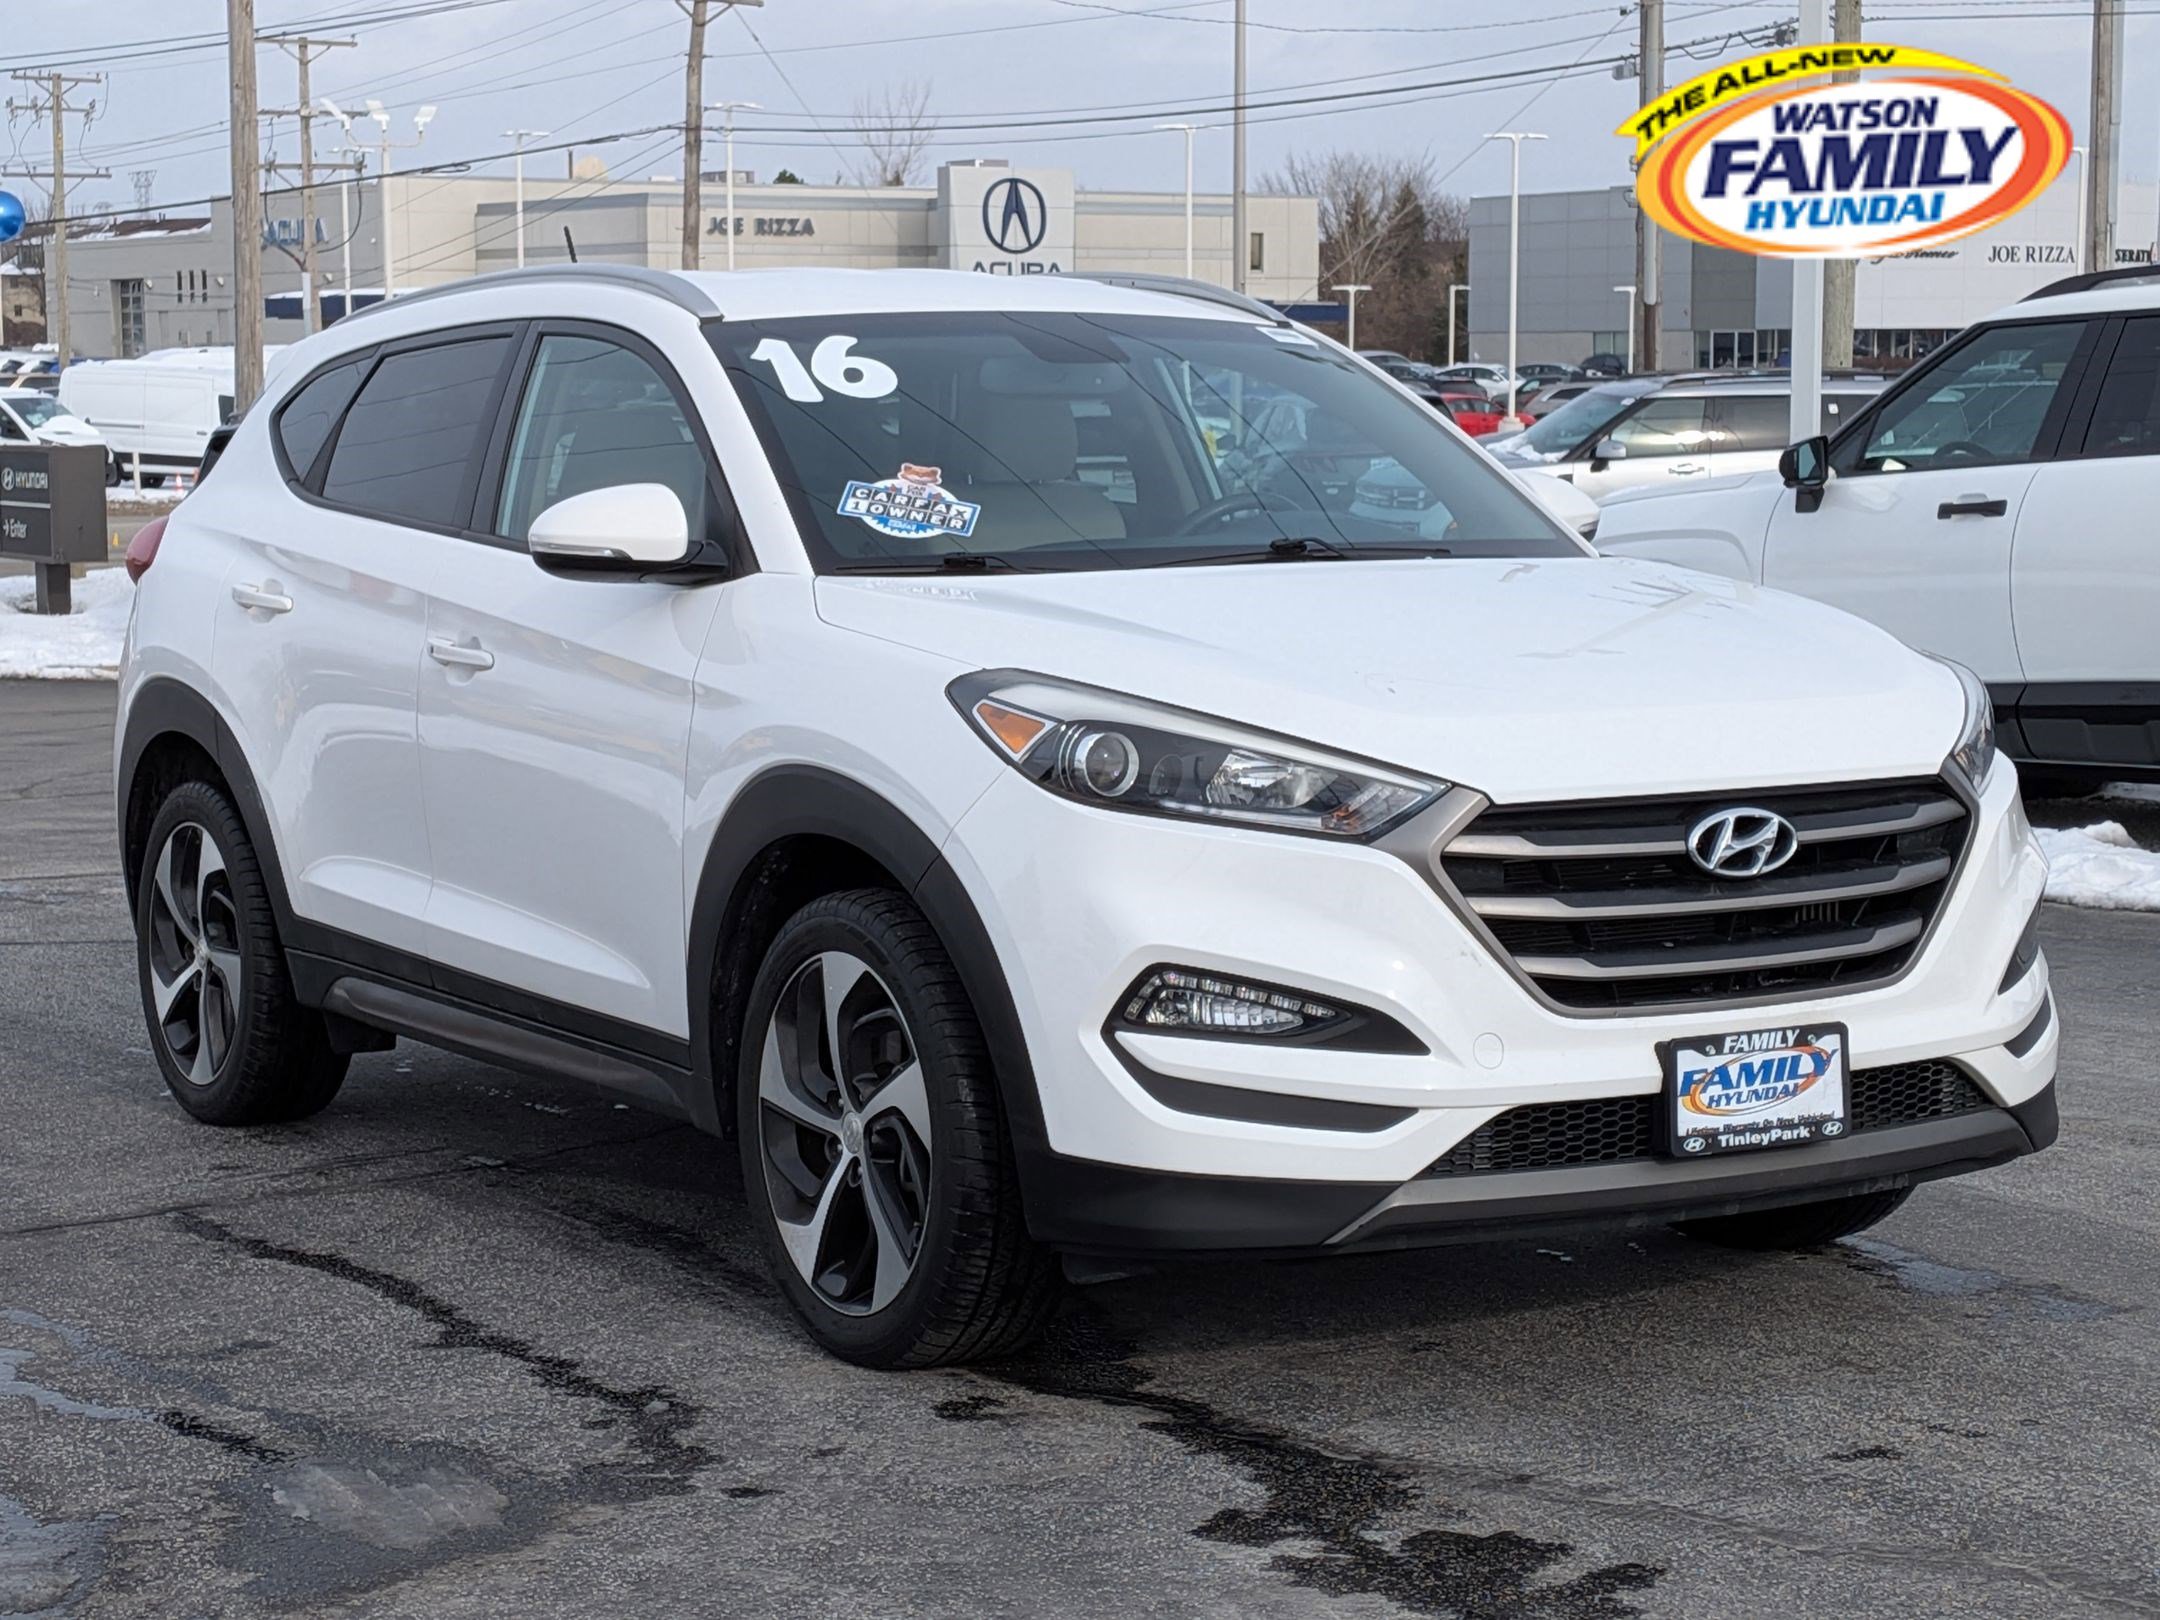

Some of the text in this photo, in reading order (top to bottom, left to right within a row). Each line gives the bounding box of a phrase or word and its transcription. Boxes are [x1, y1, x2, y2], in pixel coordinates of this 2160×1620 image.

[265, 218, 328, 245] ACUA
[706, 217, 815, 236] JOE RIZZA
[1988, 246, 2075, 263] JOE RIZZA
[750, 335, 898, 402] 16
[15, 472, 48, 489] HYUNDAI
[851, 501, 861, 510] 1
[870, 504, 963, 529] OWNER
[855, 488, 967, 519] CARFAX
[10, 519, 27, 538] Enter
[1723, 1029, 1799, 1053] FAMILY
[1679, 1049, 1839, 1097] FAMILY
[1706, 1082, 1800, 1108] HYUNDAI
